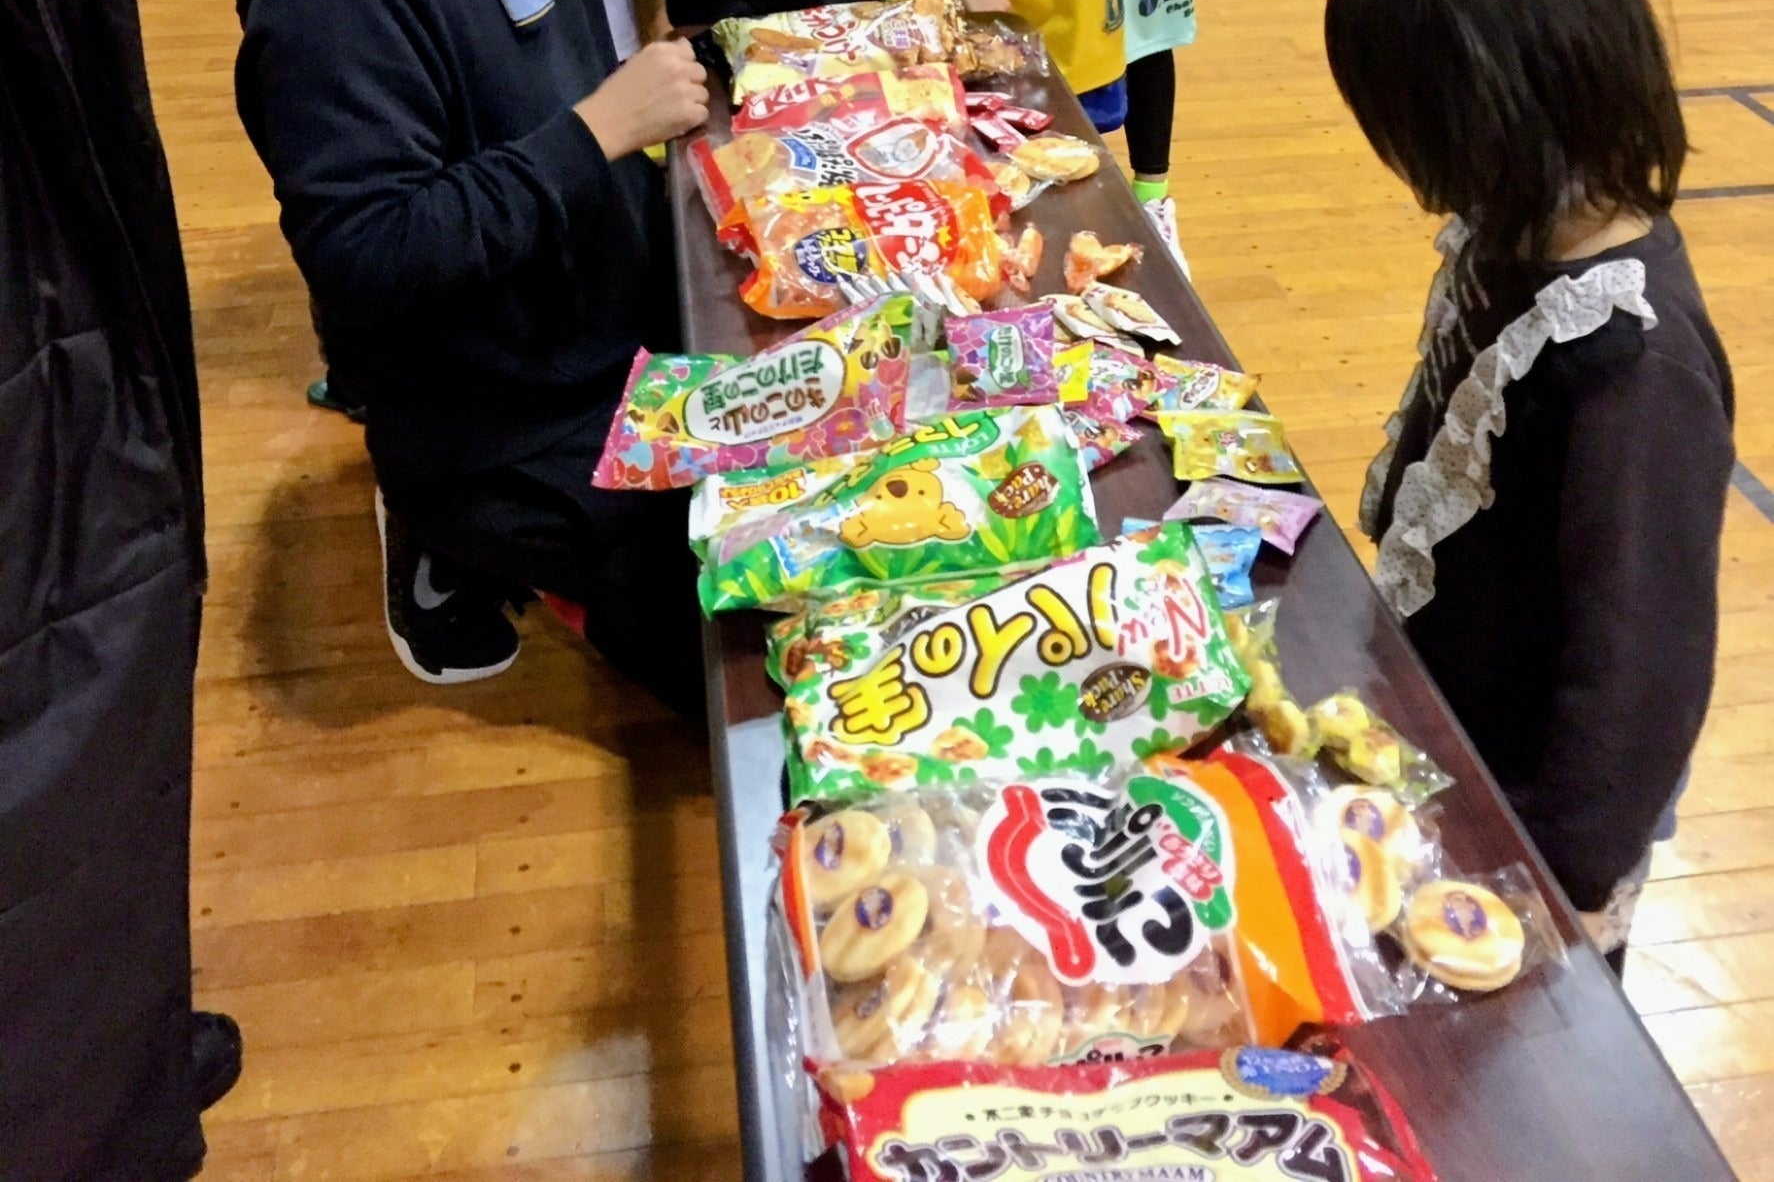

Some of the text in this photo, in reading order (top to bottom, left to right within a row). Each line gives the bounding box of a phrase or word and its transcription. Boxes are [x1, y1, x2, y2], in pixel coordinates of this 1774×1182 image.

[699, 345, 826, 415] たけのこの里
[1013, 474, 1060, 510] hare
[829, 562, 1120, 748] パイの実
[880, 1113, 1346, 1182] カントリーマアム
